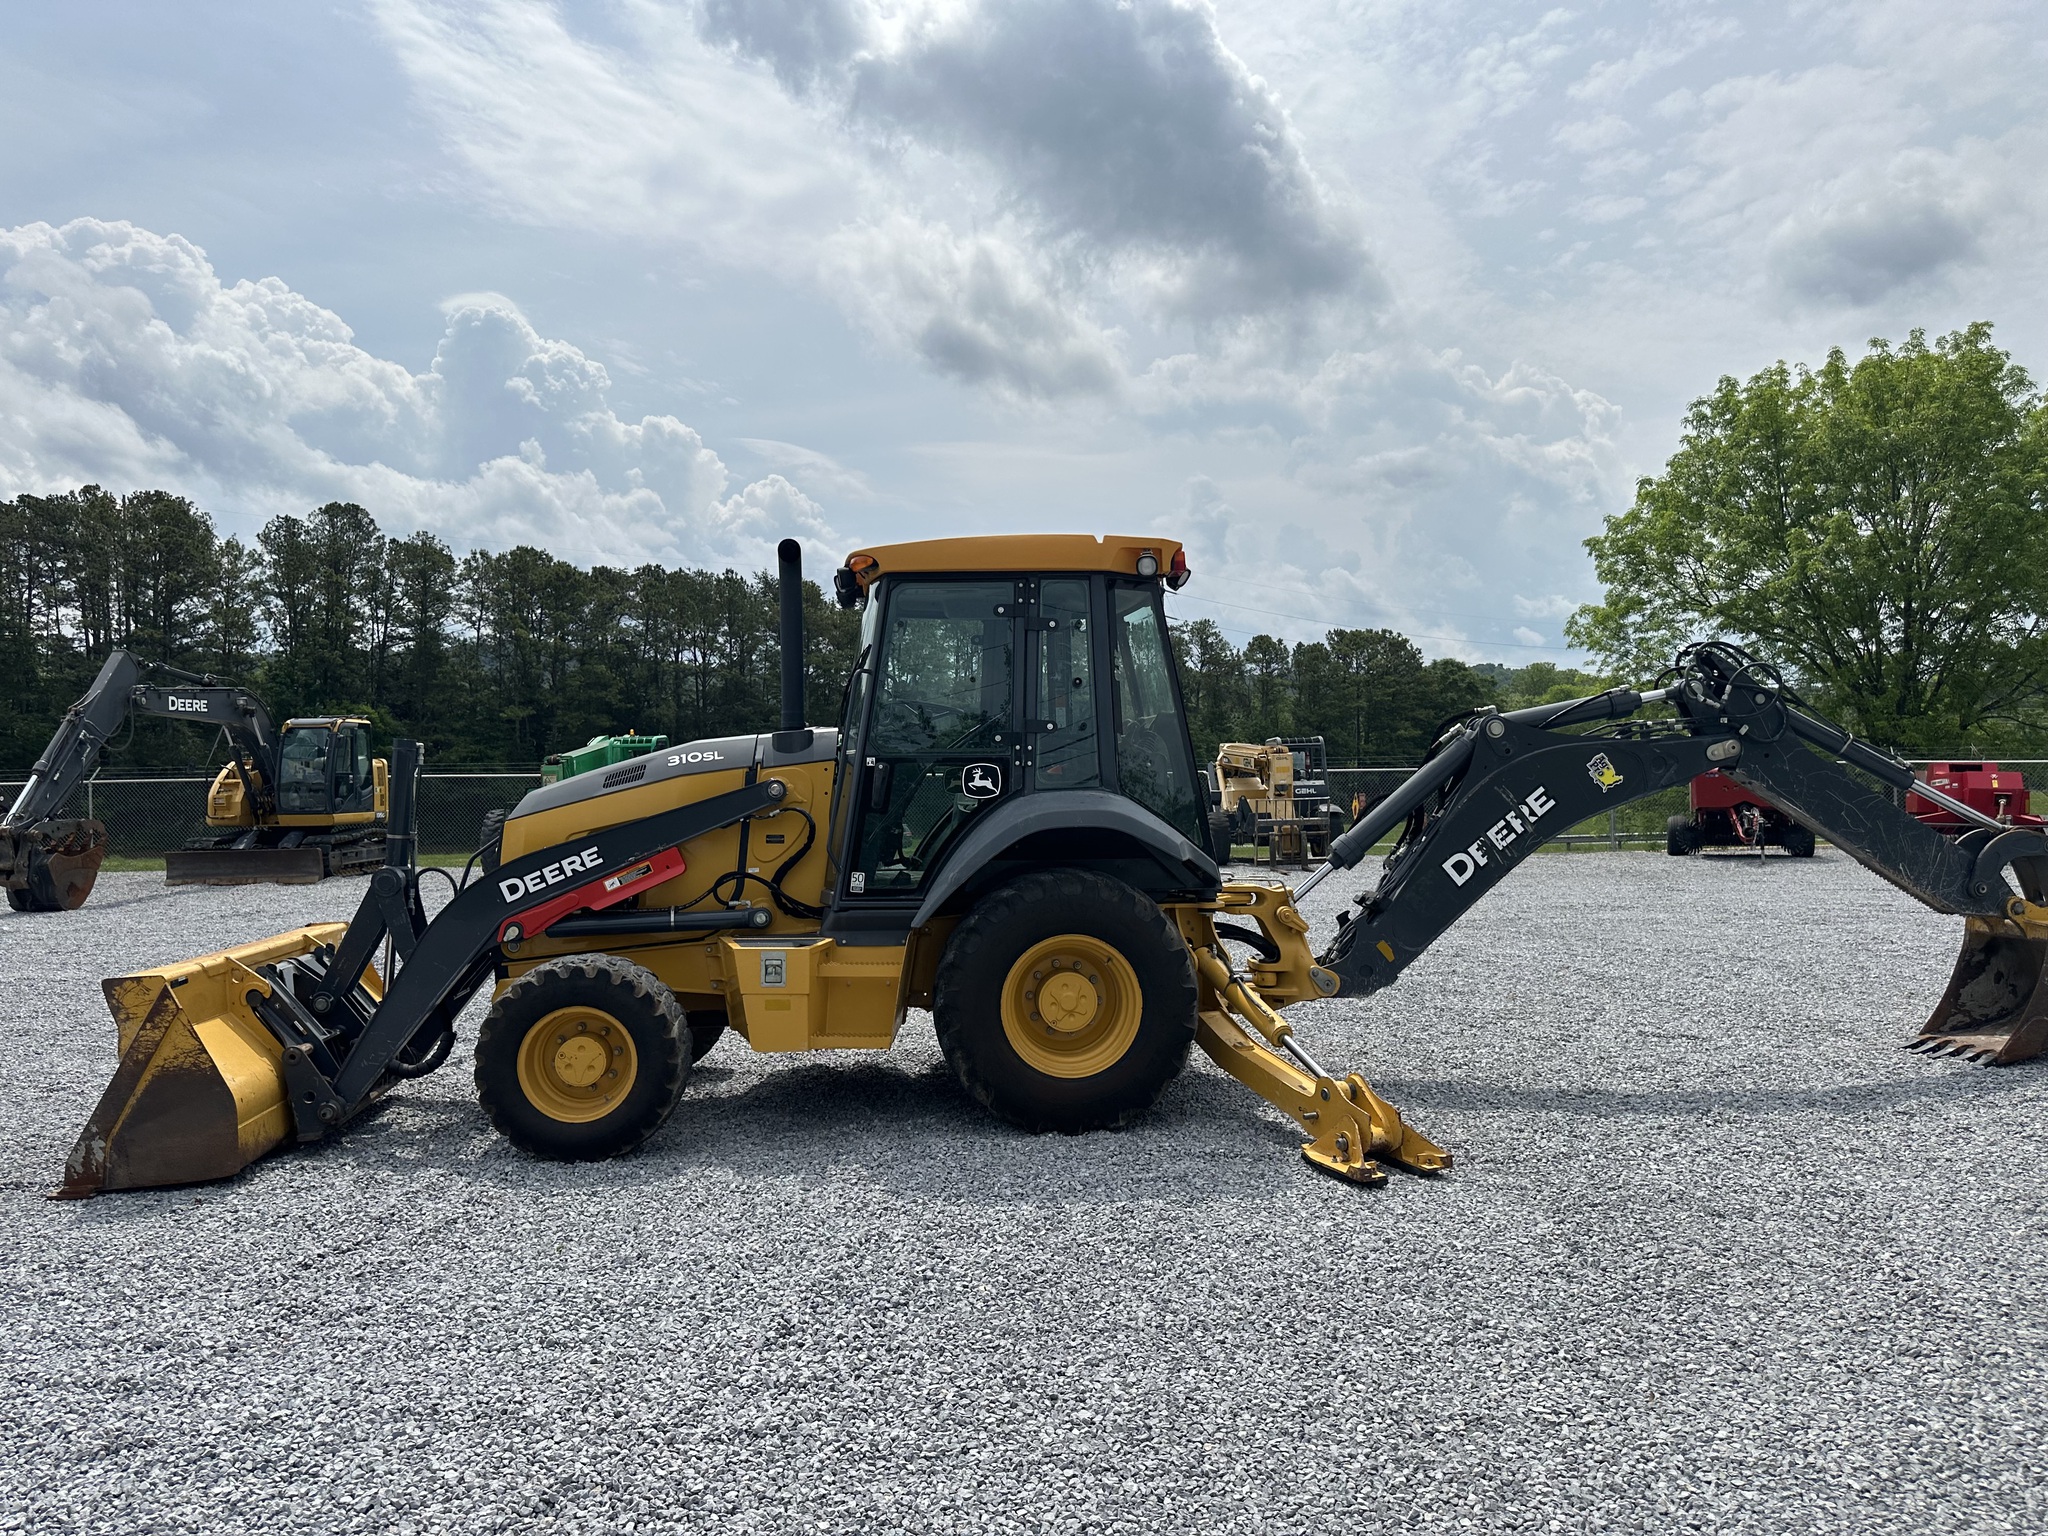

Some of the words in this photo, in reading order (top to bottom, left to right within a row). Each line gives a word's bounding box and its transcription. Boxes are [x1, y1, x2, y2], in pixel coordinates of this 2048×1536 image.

[168, 695, 208, 712] DEERE
[667, 750, 725, 767] 310SL
[498, 846, 604, 903] DEERE
[852, 873, 864, 883] 50
